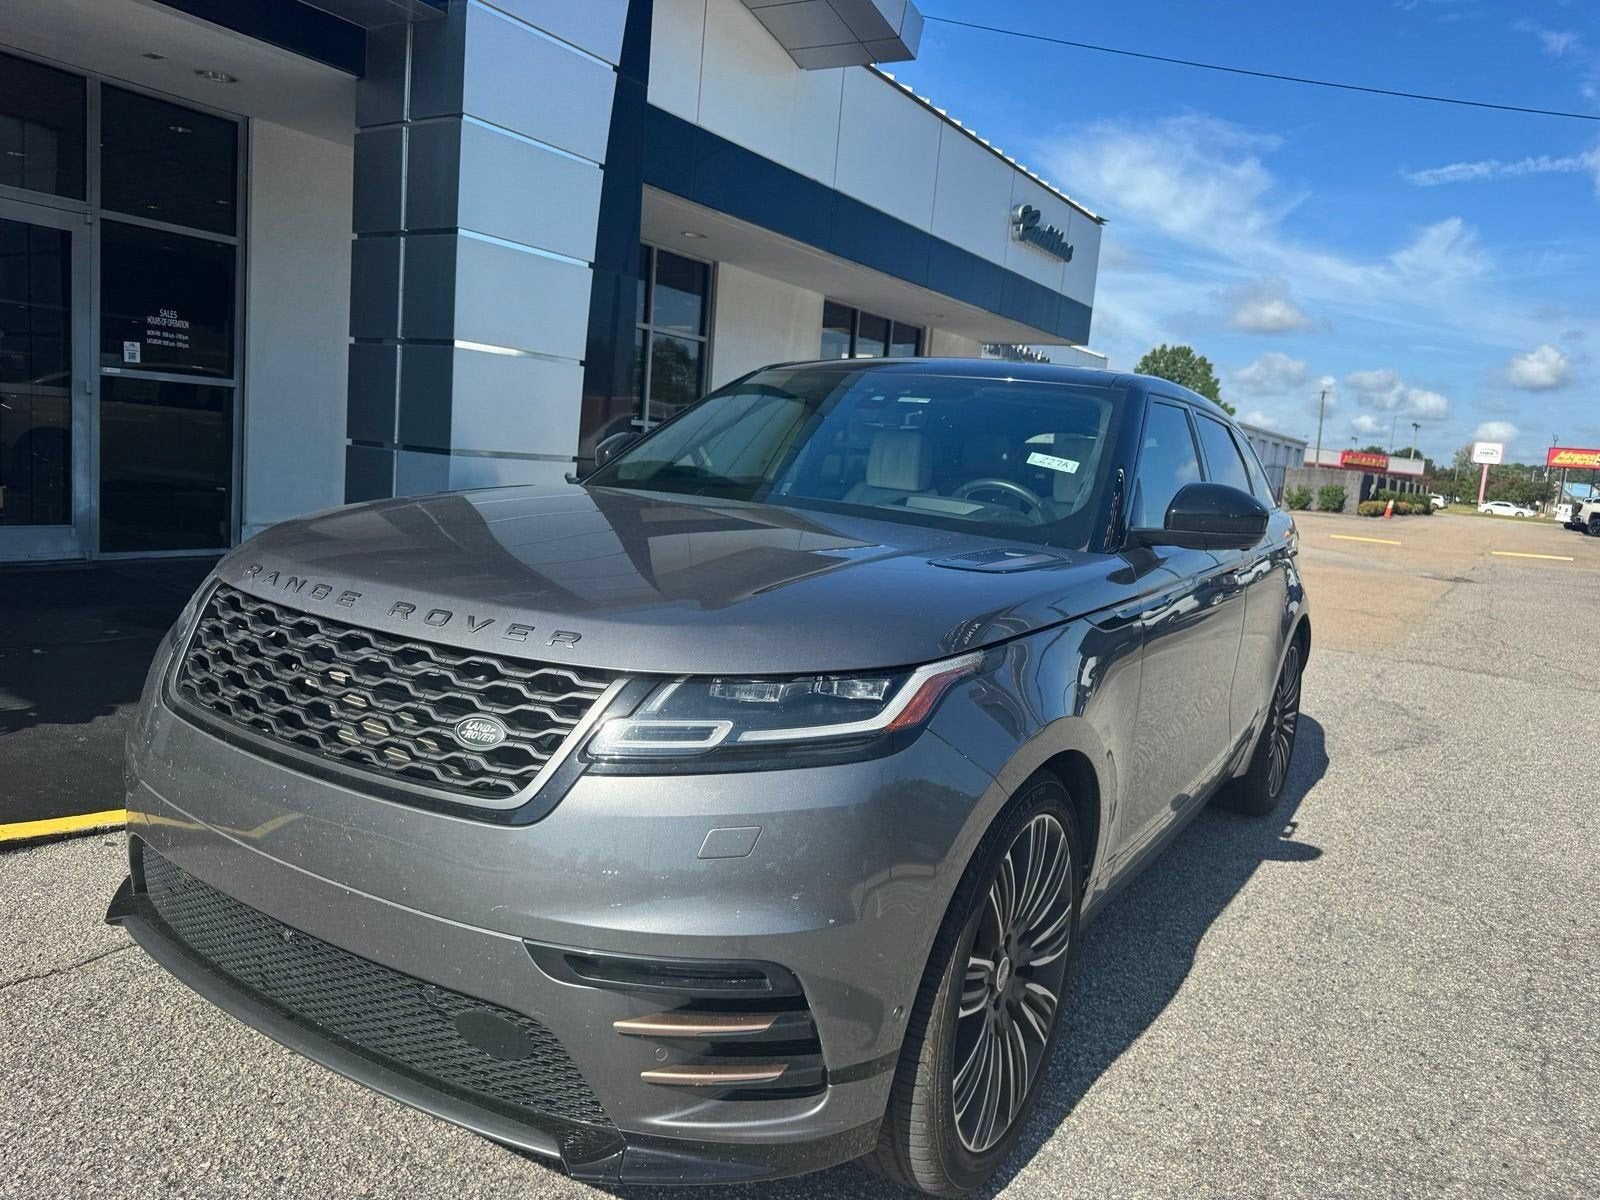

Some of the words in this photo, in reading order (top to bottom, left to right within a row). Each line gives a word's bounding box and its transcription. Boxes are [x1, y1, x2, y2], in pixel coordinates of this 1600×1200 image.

[160, 308, 178, 319] SALES
[147, 315, 161, 325] HOURS
[161, 317, 168, 326] OF
[168, 319, 189, 329] OPERATION
[243, 562, 363, 609] RANGE
[387, 600, 583, 650] ROVER
[465, 720, 492, 733] LAND
[464, 729, 496, 743] ROVER
